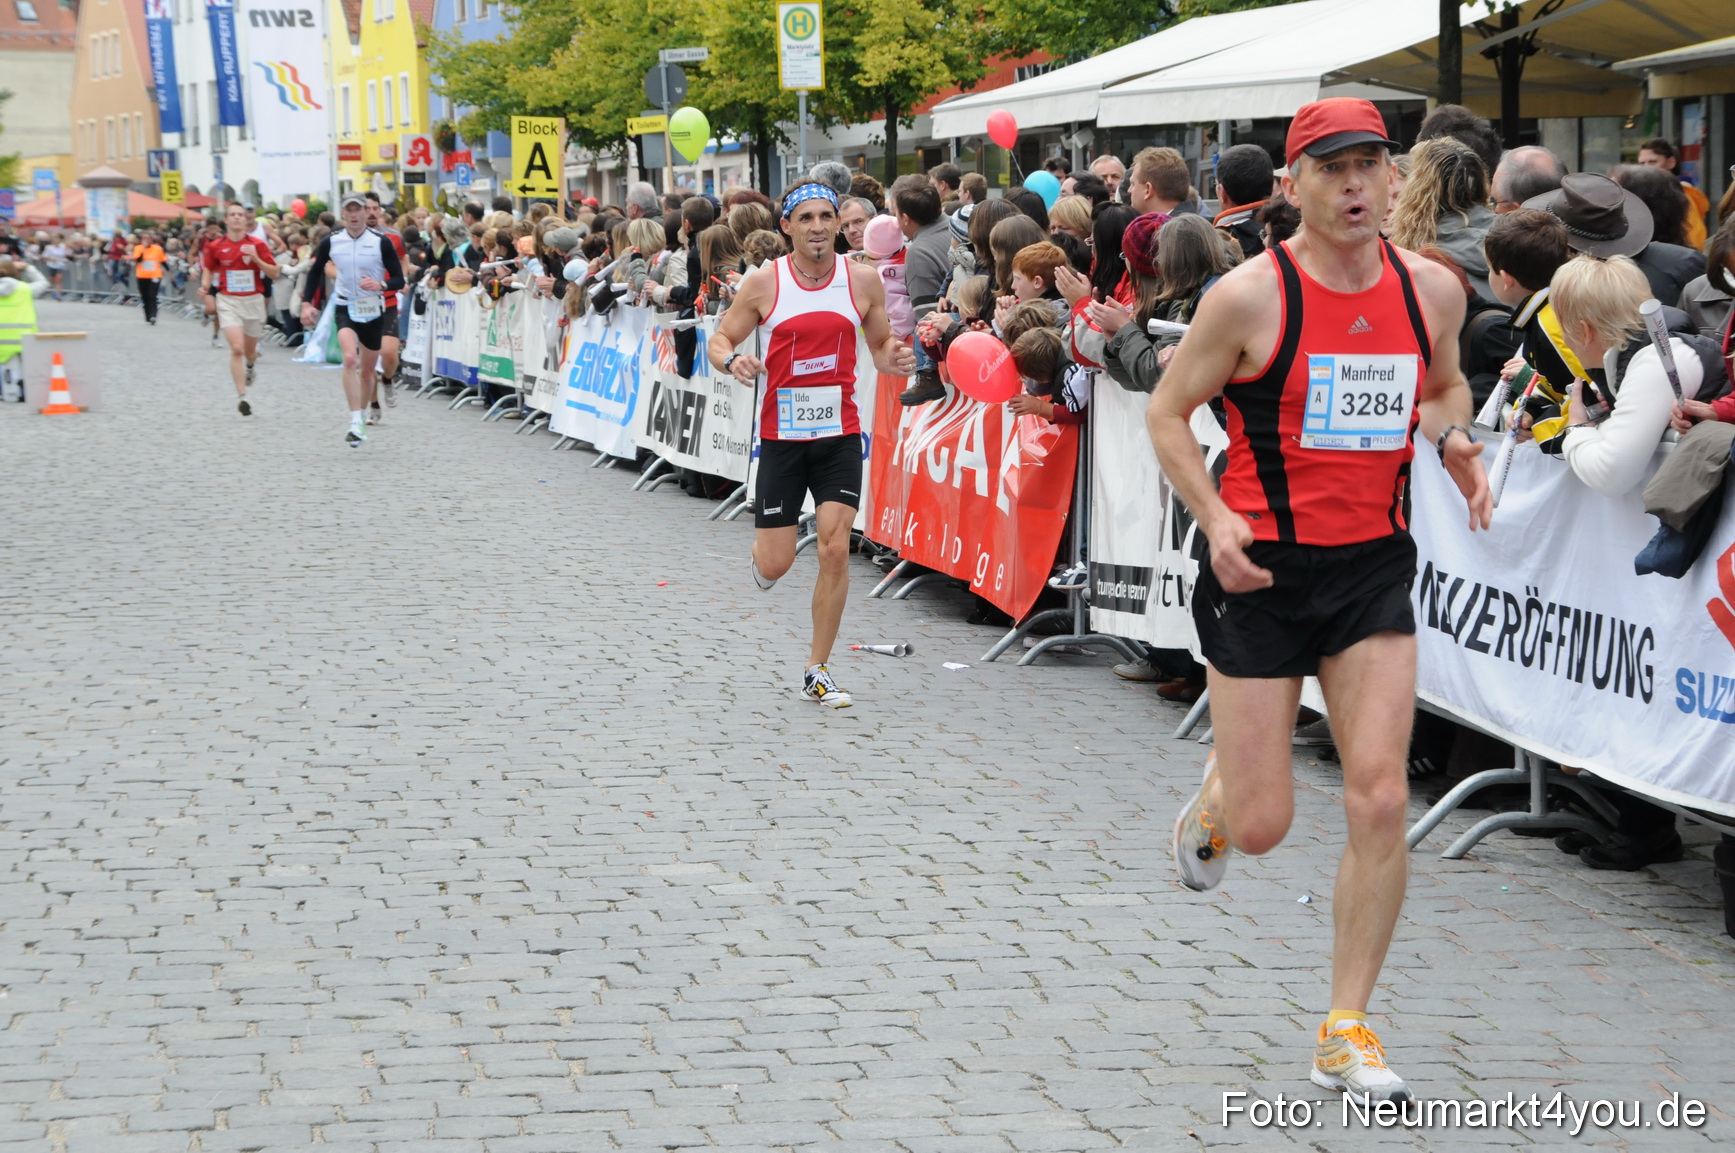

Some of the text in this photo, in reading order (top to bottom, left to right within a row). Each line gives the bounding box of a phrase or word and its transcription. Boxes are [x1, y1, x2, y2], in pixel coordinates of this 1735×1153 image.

[792, 15, 808, 33] H
[518, 120, 558, 136] Block
[636, 120, 662, 130] Toiletten
[523, 142, 553, 180] A
[167, 180, 179, 196] B
[1348, 325, 1373, 335] adidas
[804, 360, 825, 371] DEHN
[1341, 364, 1395, 382] Manfred
[794, 392, 810, 403] Udo
[1314, 391, 1322, 404] A
[1340, 392, 1405, 416] 3284
[781, 406, 787, 415] A
[796, 406, 834, 422] 2328
